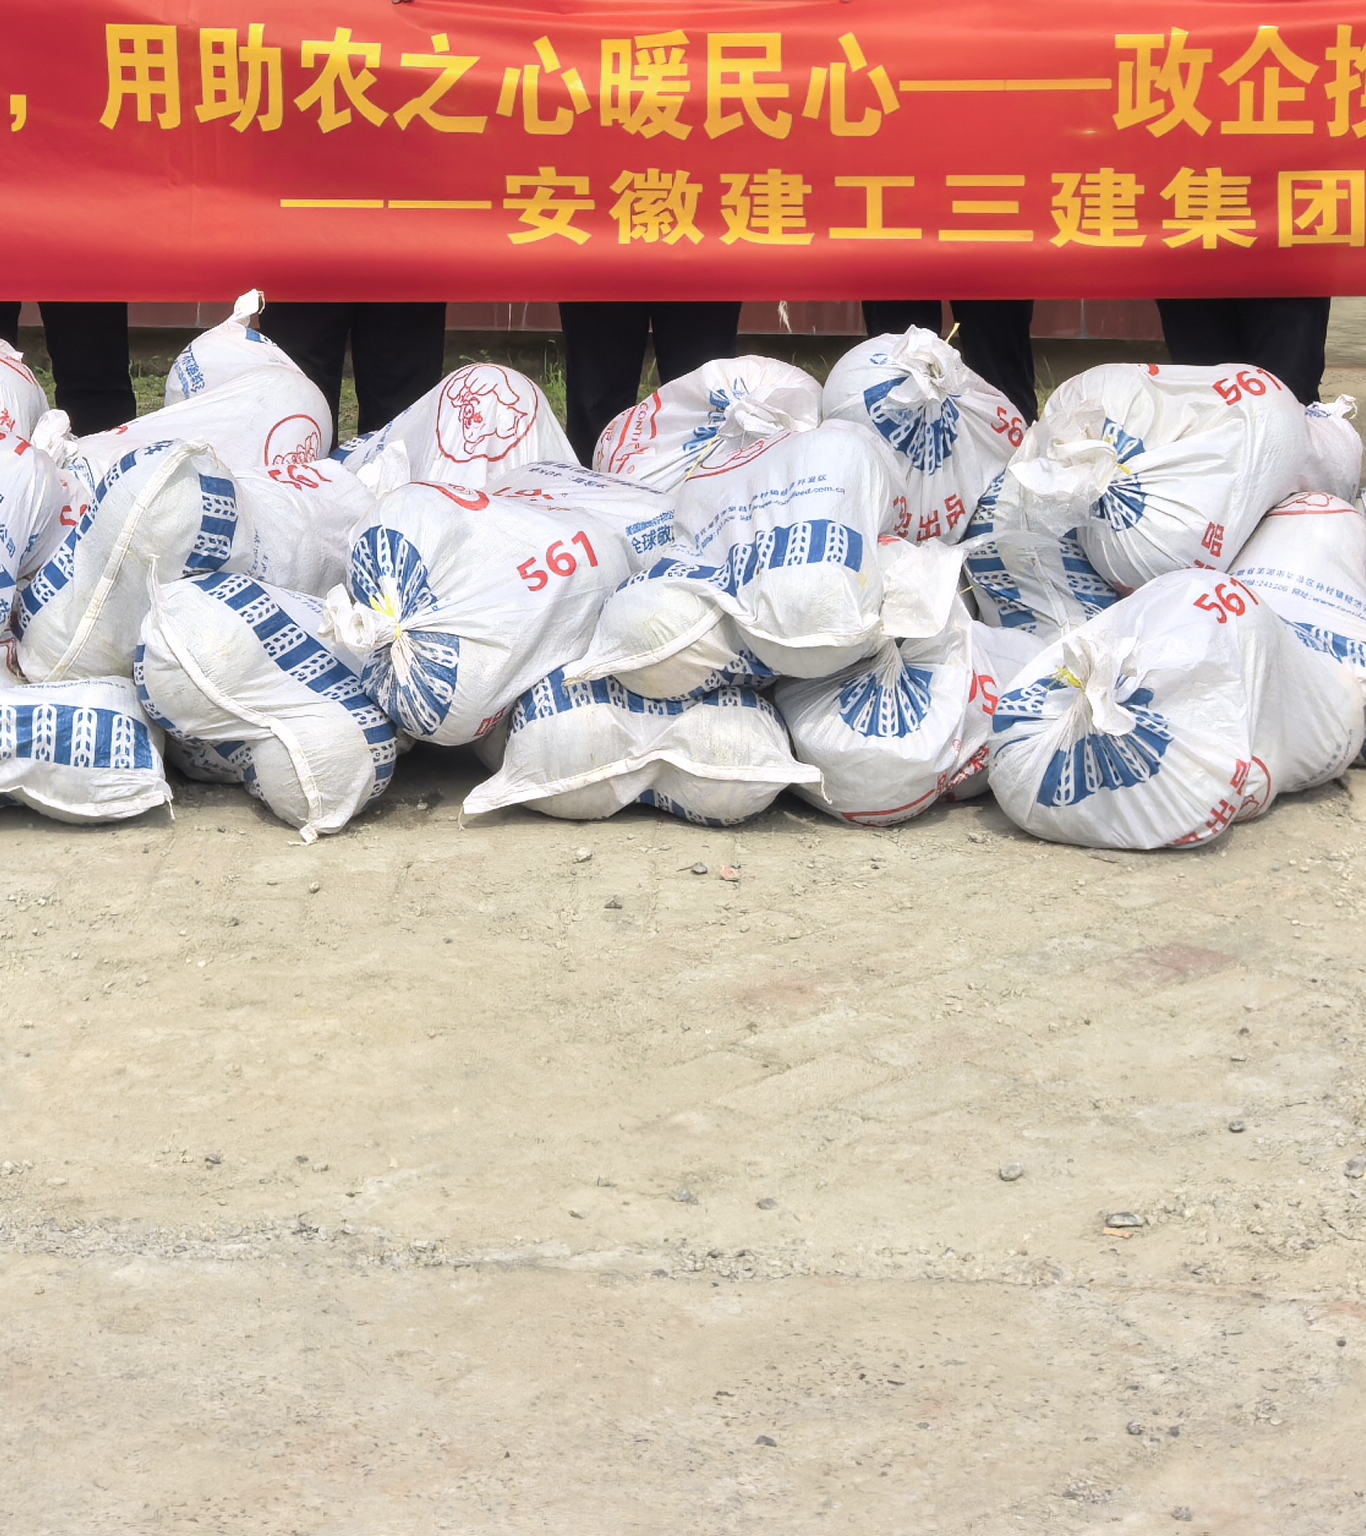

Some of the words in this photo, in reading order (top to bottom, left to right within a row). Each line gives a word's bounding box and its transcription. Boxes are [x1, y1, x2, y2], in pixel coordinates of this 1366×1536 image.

[1212, 366, 1283, 408] 561
[516, 530, 599, 593] 561
[1193, 577, 1259, 625] 561
